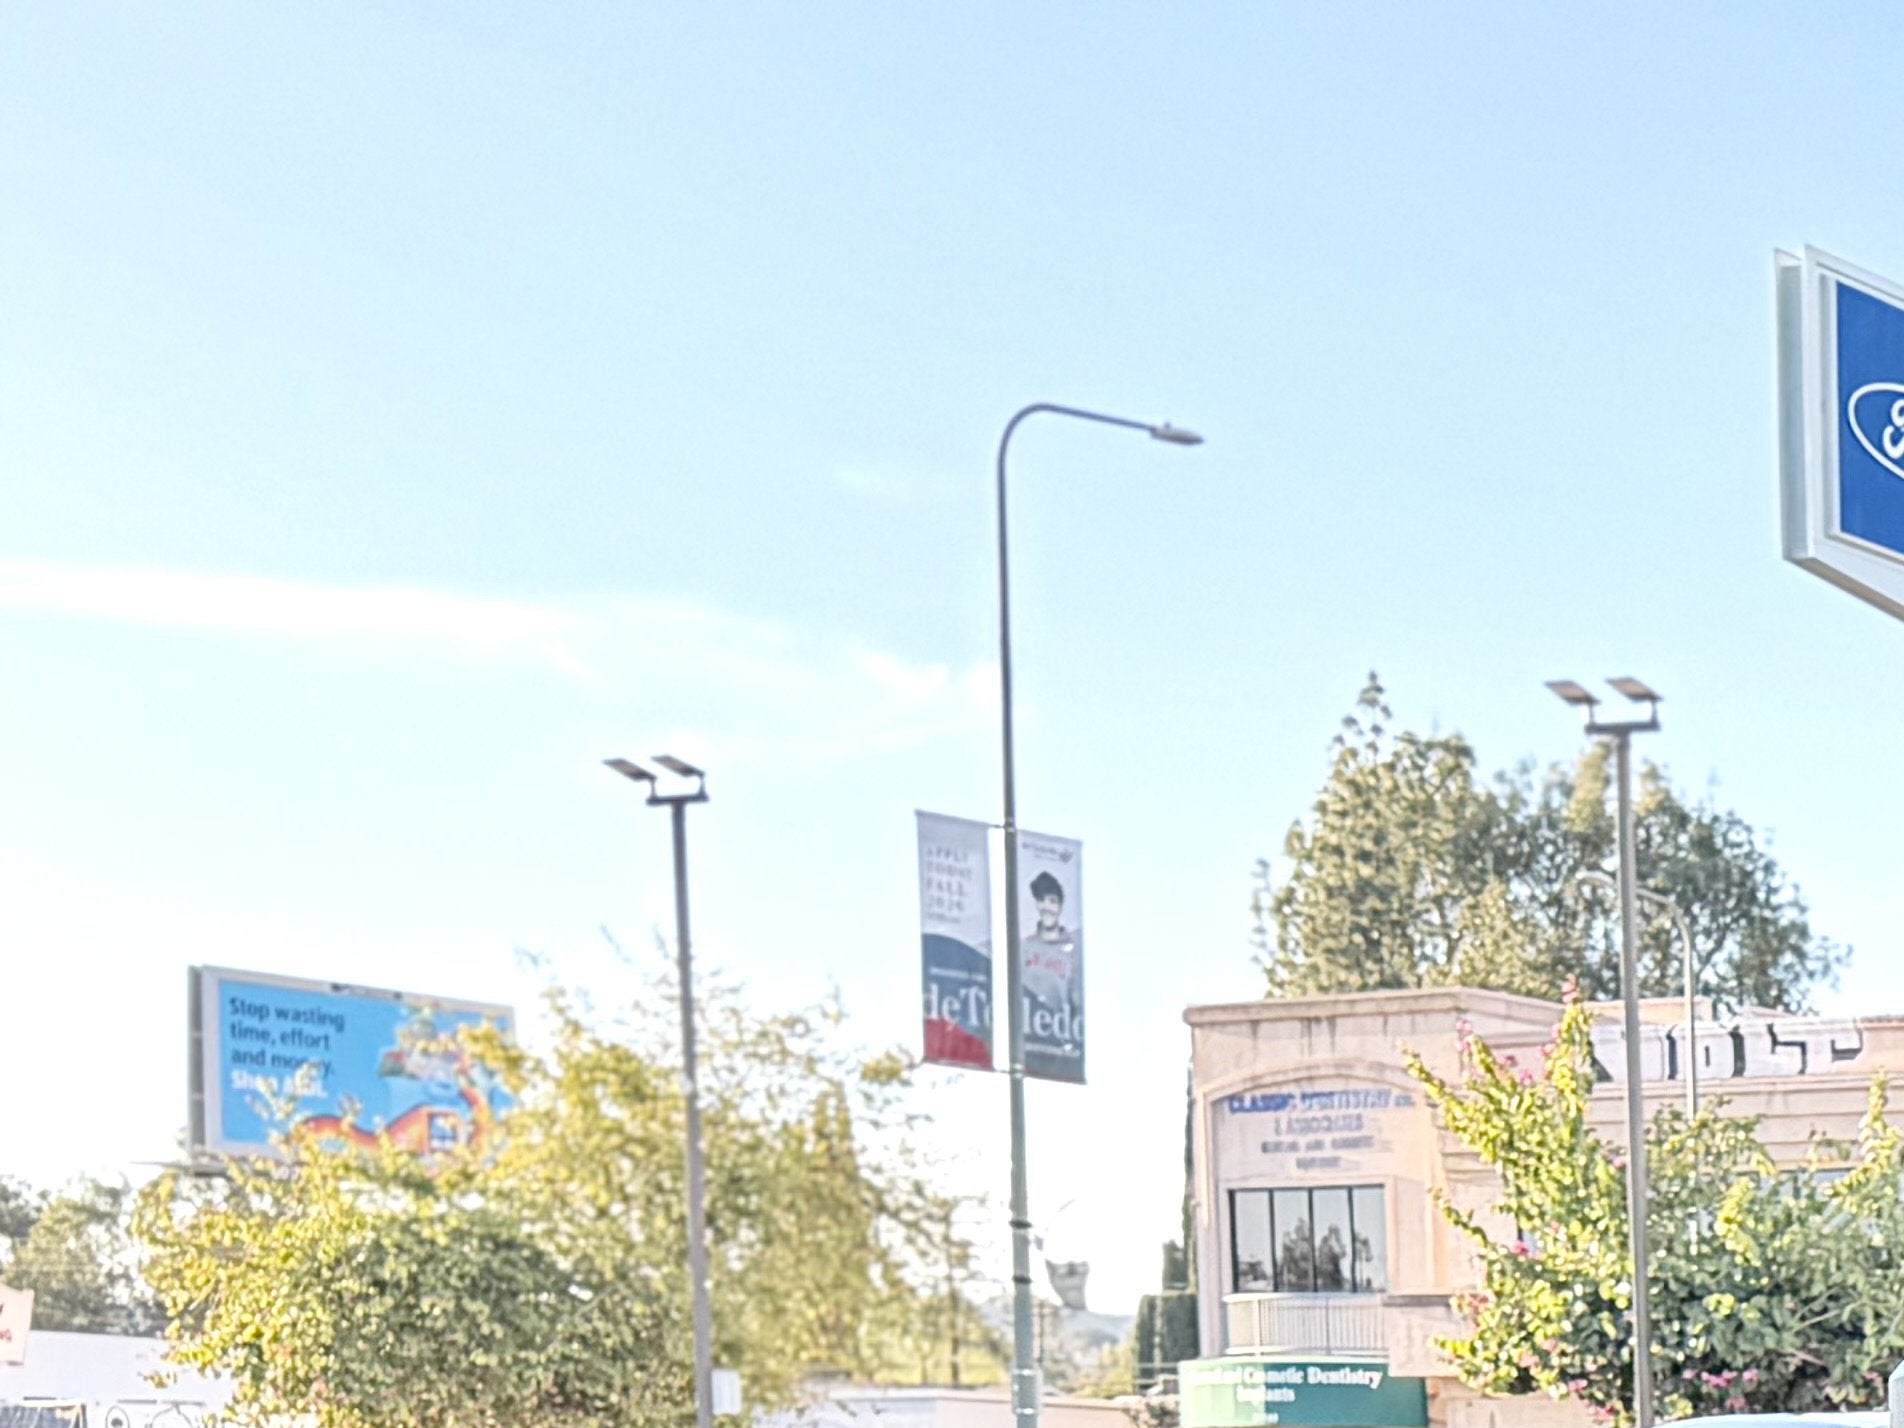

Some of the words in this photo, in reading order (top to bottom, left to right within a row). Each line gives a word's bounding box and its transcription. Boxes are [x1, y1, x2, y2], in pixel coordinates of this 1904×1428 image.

[229, 997, 270, 1022] Stop
[275, 1006, 345, 1033] wasting
[230, 1021, 277, 1046] time,
[280, 1028, 330, 1051] effort
[232, 1049, 267, 1067] and
[1306, 1365, 1383, 1390] Dentistry
